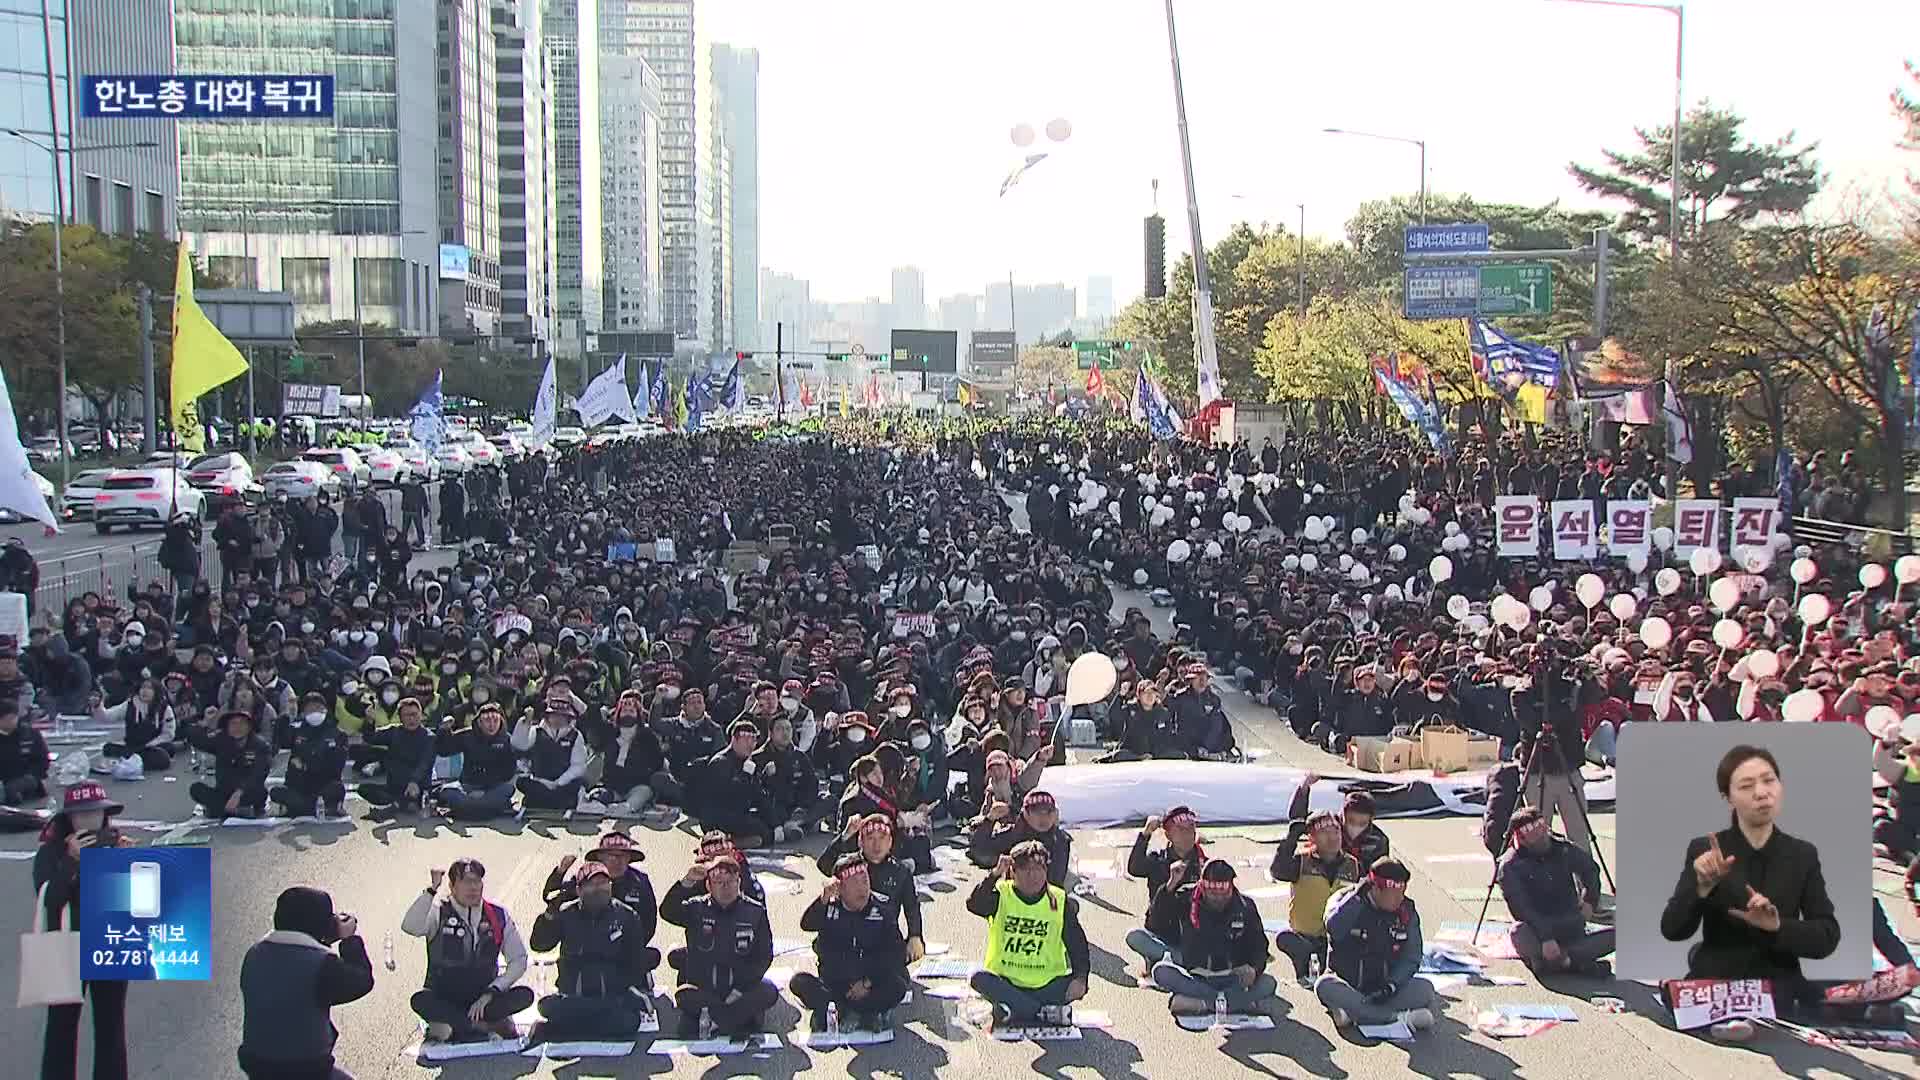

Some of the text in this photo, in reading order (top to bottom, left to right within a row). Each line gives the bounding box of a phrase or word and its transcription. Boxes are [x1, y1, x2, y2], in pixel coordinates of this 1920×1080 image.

[1501, 505, 1773, 547] 윤 석 열 퇴 진
[1004, 915, 1049, 936] 공공성
[1004, 936, 1043, 956] 사수!
